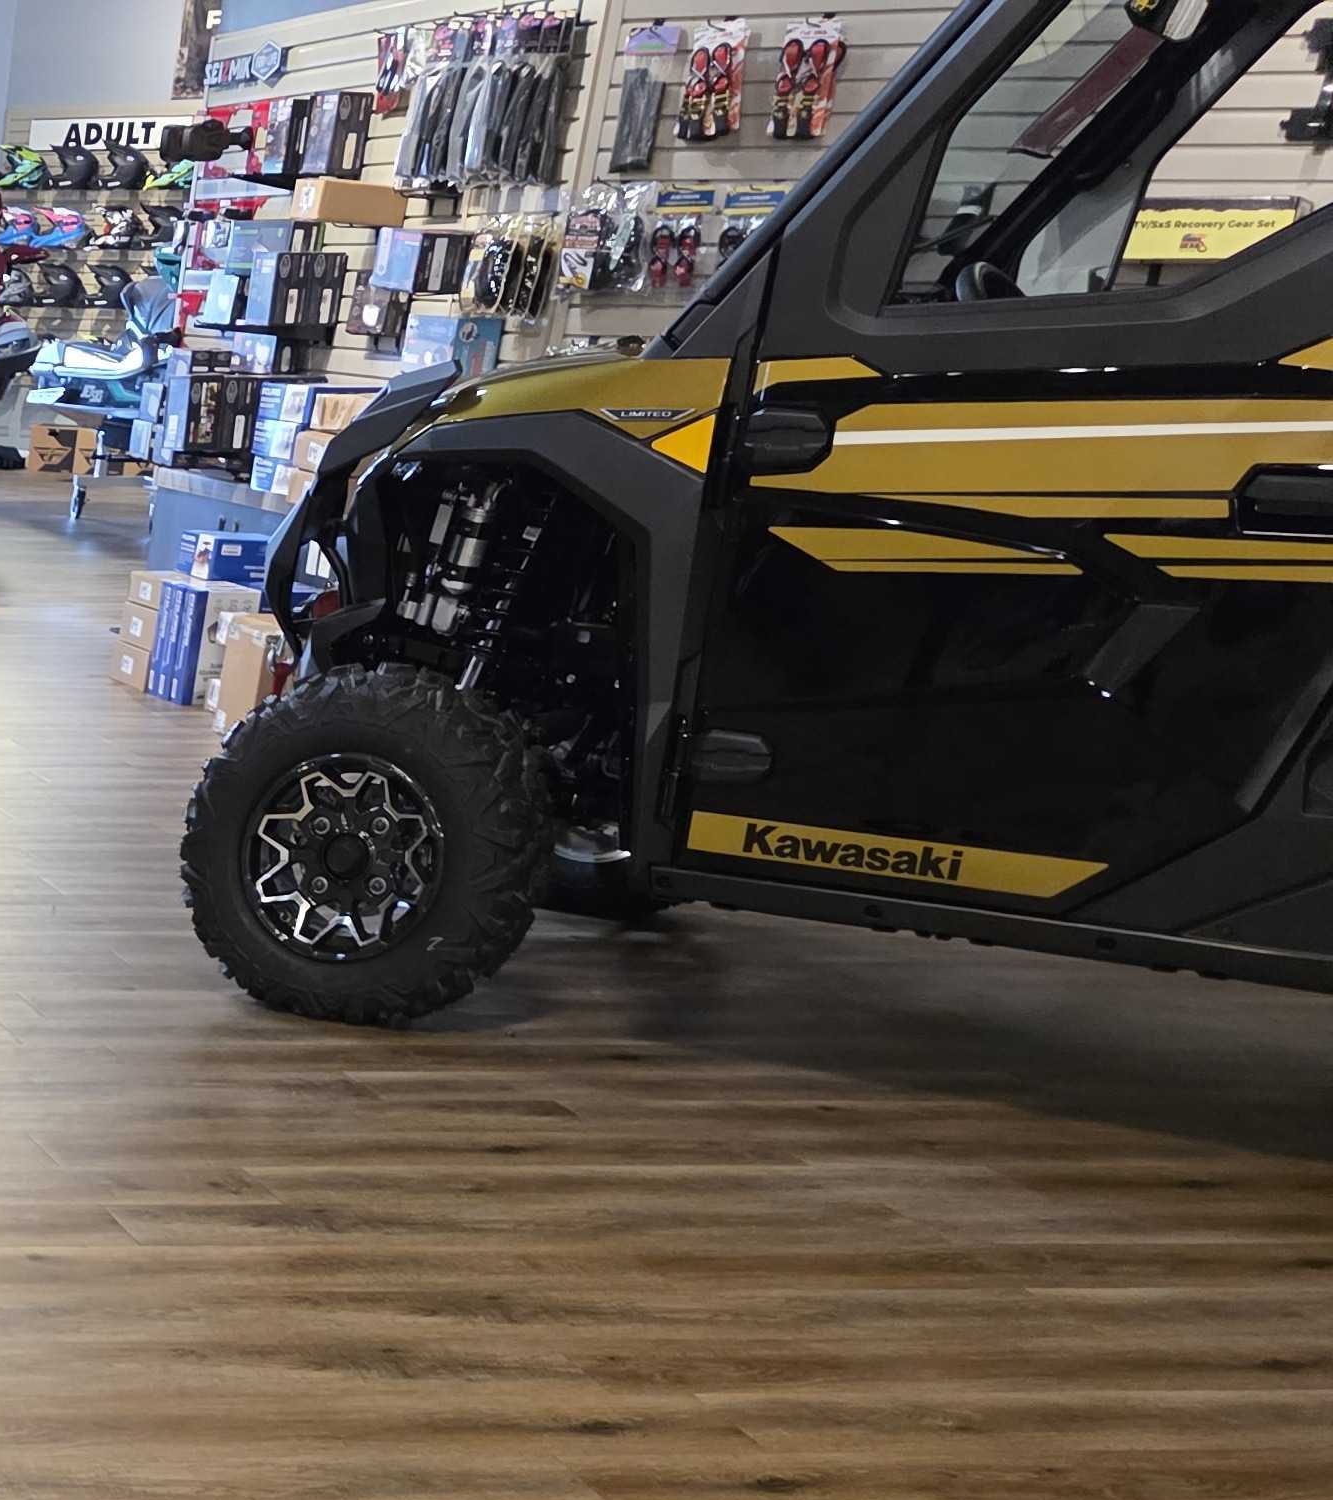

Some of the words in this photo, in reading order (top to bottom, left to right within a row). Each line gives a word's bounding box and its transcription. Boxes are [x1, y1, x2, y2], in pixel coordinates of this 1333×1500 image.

[63, 121, 156, 147] ADULT
[1133, 219, 1171, 230] TV/SxS
[1174, 219, 1225, 230] Recovery
[1228, 219, 1254, 229] Gear
[1257, 219, 1275, 229] Set
[742, 822, 964, 881] Kawasaki
